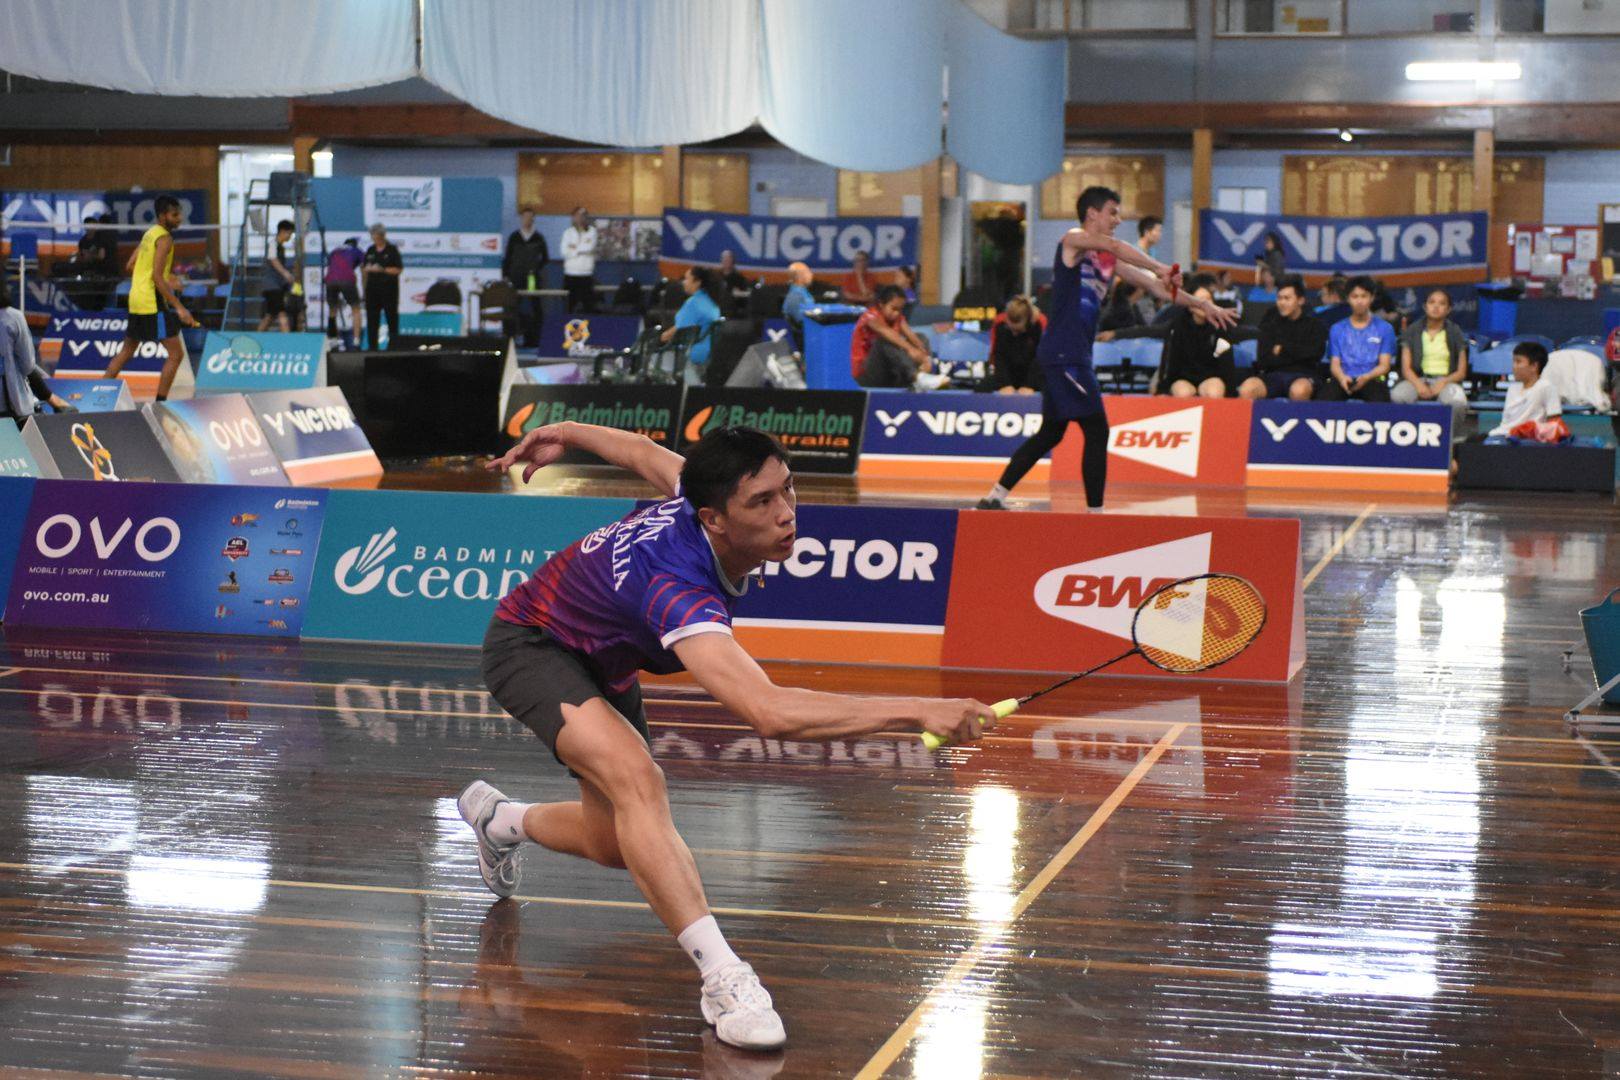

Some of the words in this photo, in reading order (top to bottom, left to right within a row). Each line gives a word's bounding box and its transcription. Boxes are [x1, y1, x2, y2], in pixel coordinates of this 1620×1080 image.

[31, 199, 193, 234] VICTO
[724, 221, 905, 261] VICTOR
[1277, 220, 1474, 263] VICTOR
[285, 405, 355, 434] VICTOR
[548, 401, 670, 428] Badminton
[728, 404, 854, 435] Badminton
[917, 410, 1044, 438] VICTOR
[209, 416, 262, 451] OVO
[778, 433, 850, 448] tralia
[1114, 430, 1193, 449] BWF
[1305, 418, 1443, 448] VICTOR
[35, 513, 181, 562] OVO
[413, 545, 557, 565] BADMINT
[748, 537, 939, 582] CTOR
[29, 566, 57, 574] MOBILE
[67, 567, 93, 576] SPORT
[103, 569, 166, 578] ENTERTAINMENT
[23, 590, 110, 604] ovo.com.au
[1054, 574, 1195, 610] BWF
